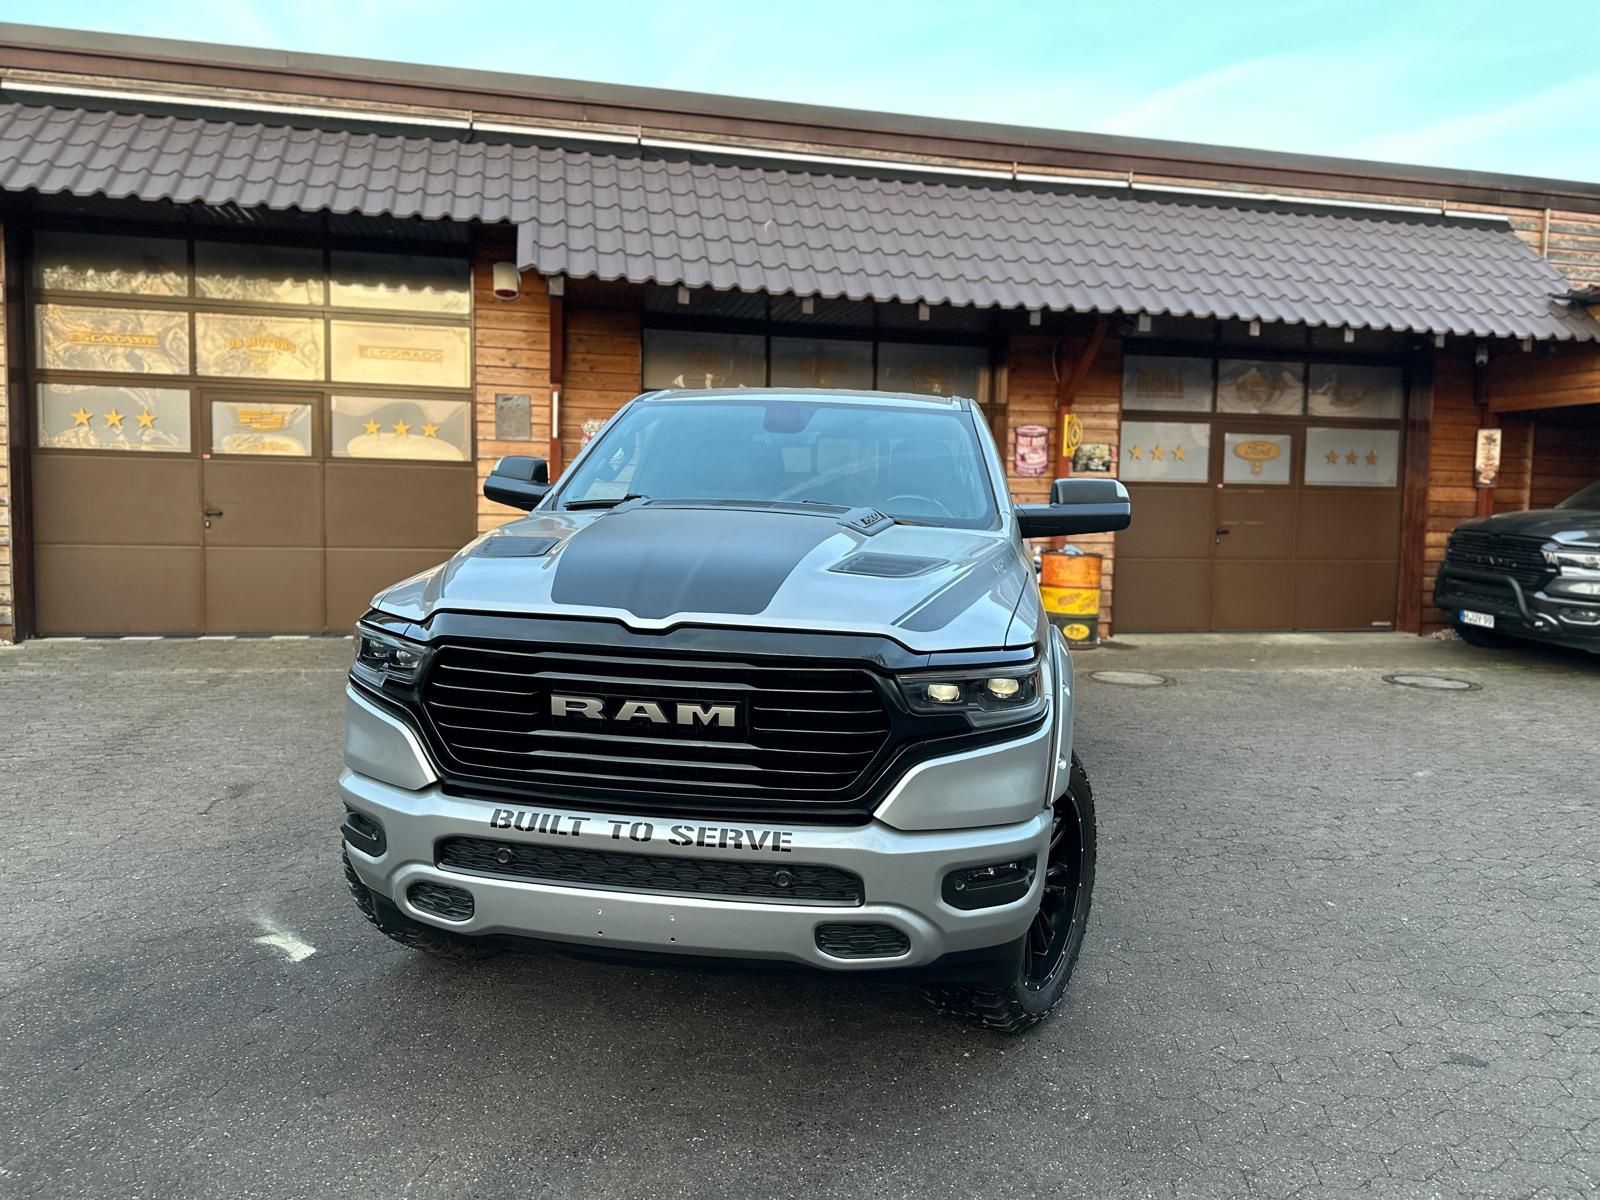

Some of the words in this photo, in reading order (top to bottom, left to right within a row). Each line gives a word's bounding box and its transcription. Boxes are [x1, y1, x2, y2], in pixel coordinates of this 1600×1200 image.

[551, 694, 737, 727] RAM
[490, 808, 590, 837] BUILT
[608, 820, 654, 842] TO
[668, 825, 793, 852] SERVE
